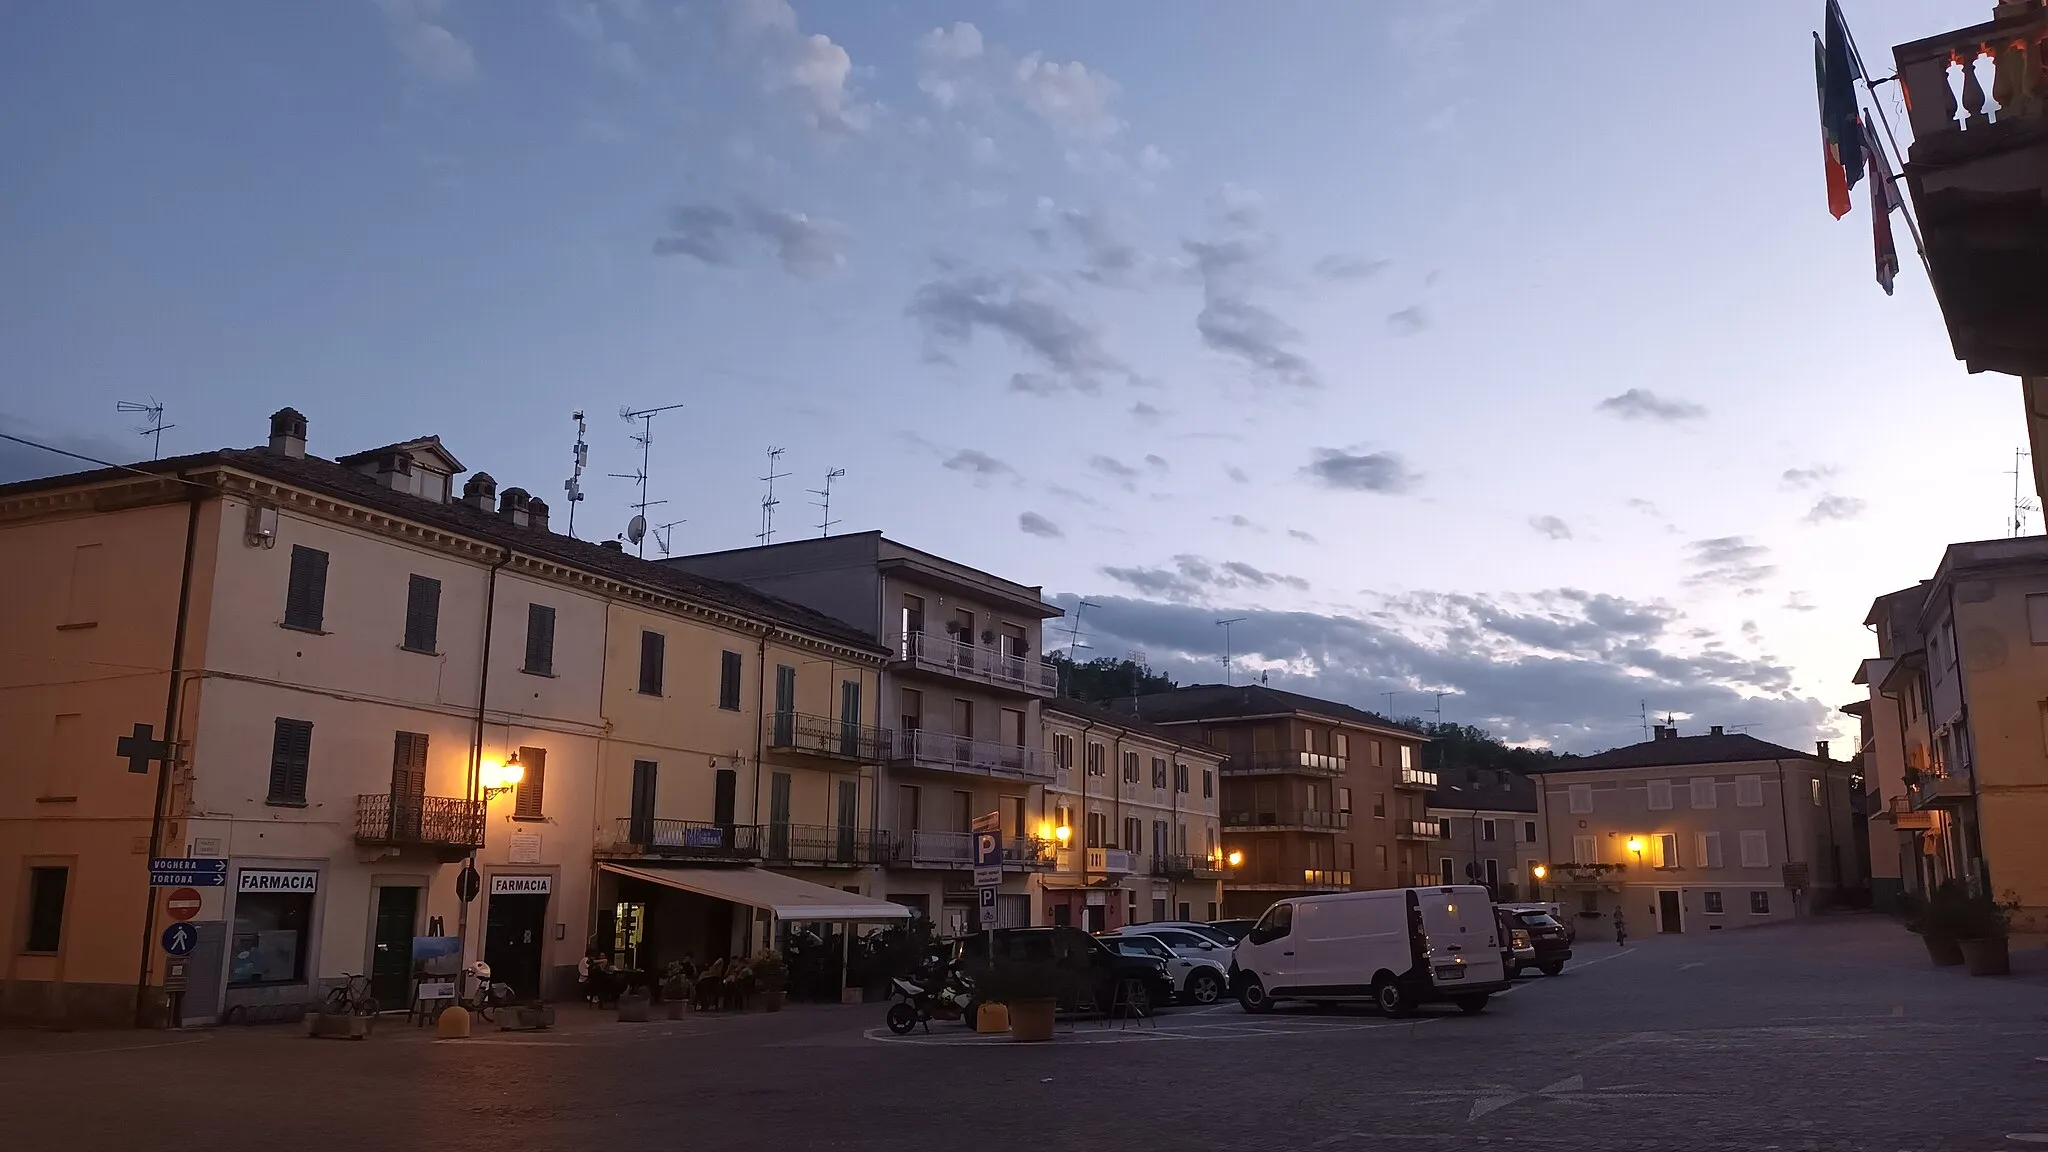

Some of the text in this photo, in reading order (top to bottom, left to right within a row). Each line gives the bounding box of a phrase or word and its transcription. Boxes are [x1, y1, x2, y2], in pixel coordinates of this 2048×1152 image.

[978, 834, 996, 864] P
[154, 859, 197, 870] VOGHERA
[152, 873, 193, 884] TORTONA
[241, 875, 314, 889] FARMACIA
[495, 880, 547, 891] FARMACIA
[983, 890, 992, 906] P
